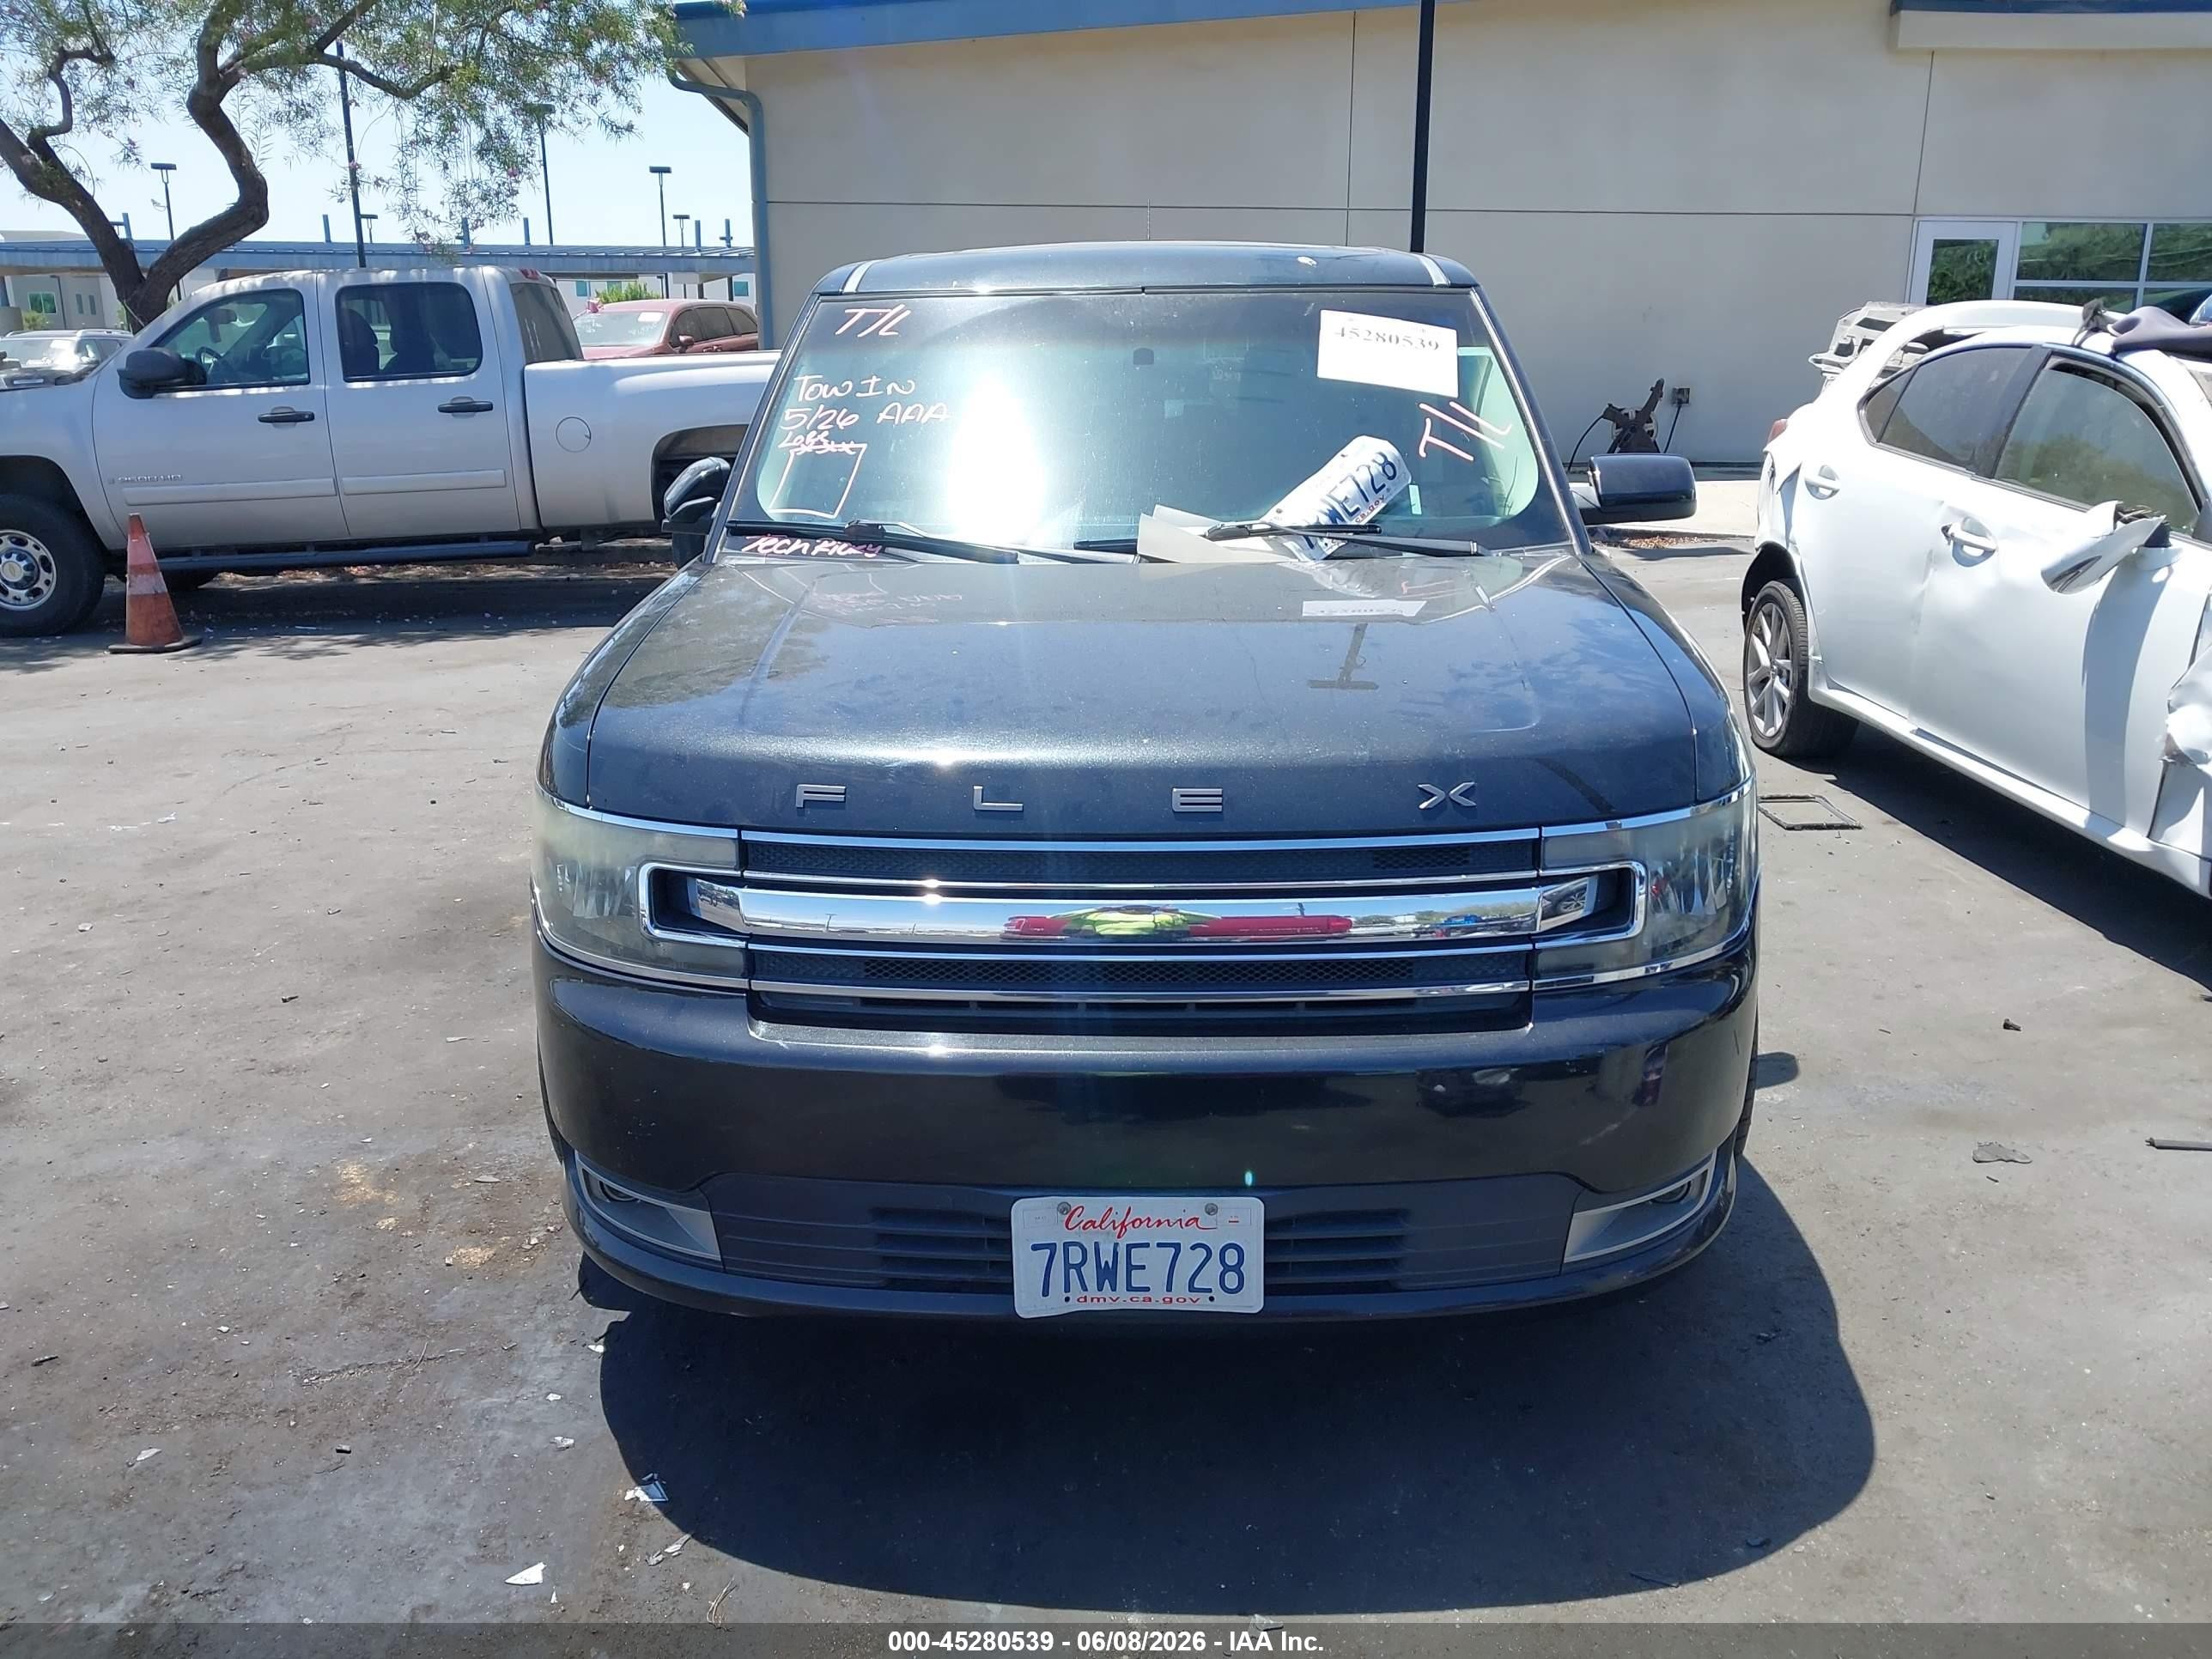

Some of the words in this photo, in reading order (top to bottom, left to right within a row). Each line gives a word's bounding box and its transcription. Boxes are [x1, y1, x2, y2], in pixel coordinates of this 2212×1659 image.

[780, 404, 860, 430] 5/26
[876, 401, 951, 424] AAA
[1064, 1206, 1218, 1239] California
[1030, 1241, 1245, 1297] 7RWE728
[1076, 1295, 1200, 1304] dmv.ca.gov
